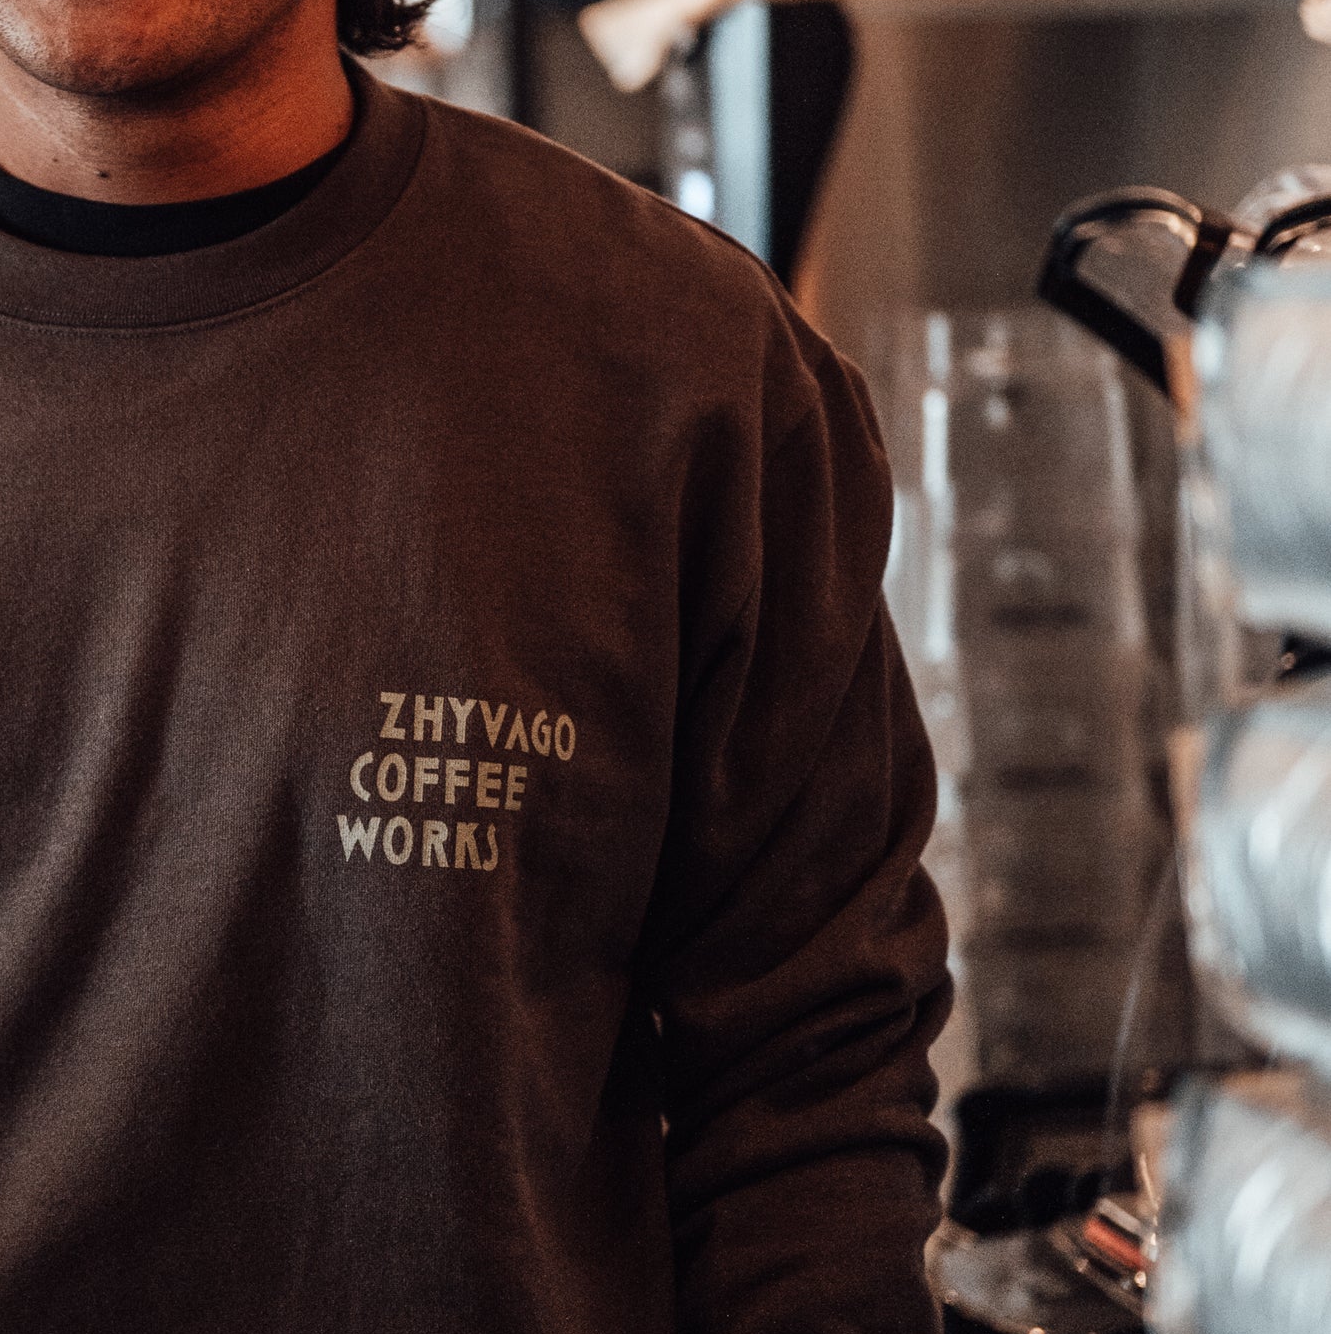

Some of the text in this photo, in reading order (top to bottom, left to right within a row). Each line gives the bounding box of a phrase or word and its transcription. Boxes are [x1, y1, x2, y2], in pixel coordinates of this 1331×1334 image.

[379, 691, 576, 761] ZHYVAGO
[349, 751, 528, 811] COFFEE
[336, 814, 499, 871] WORKS
